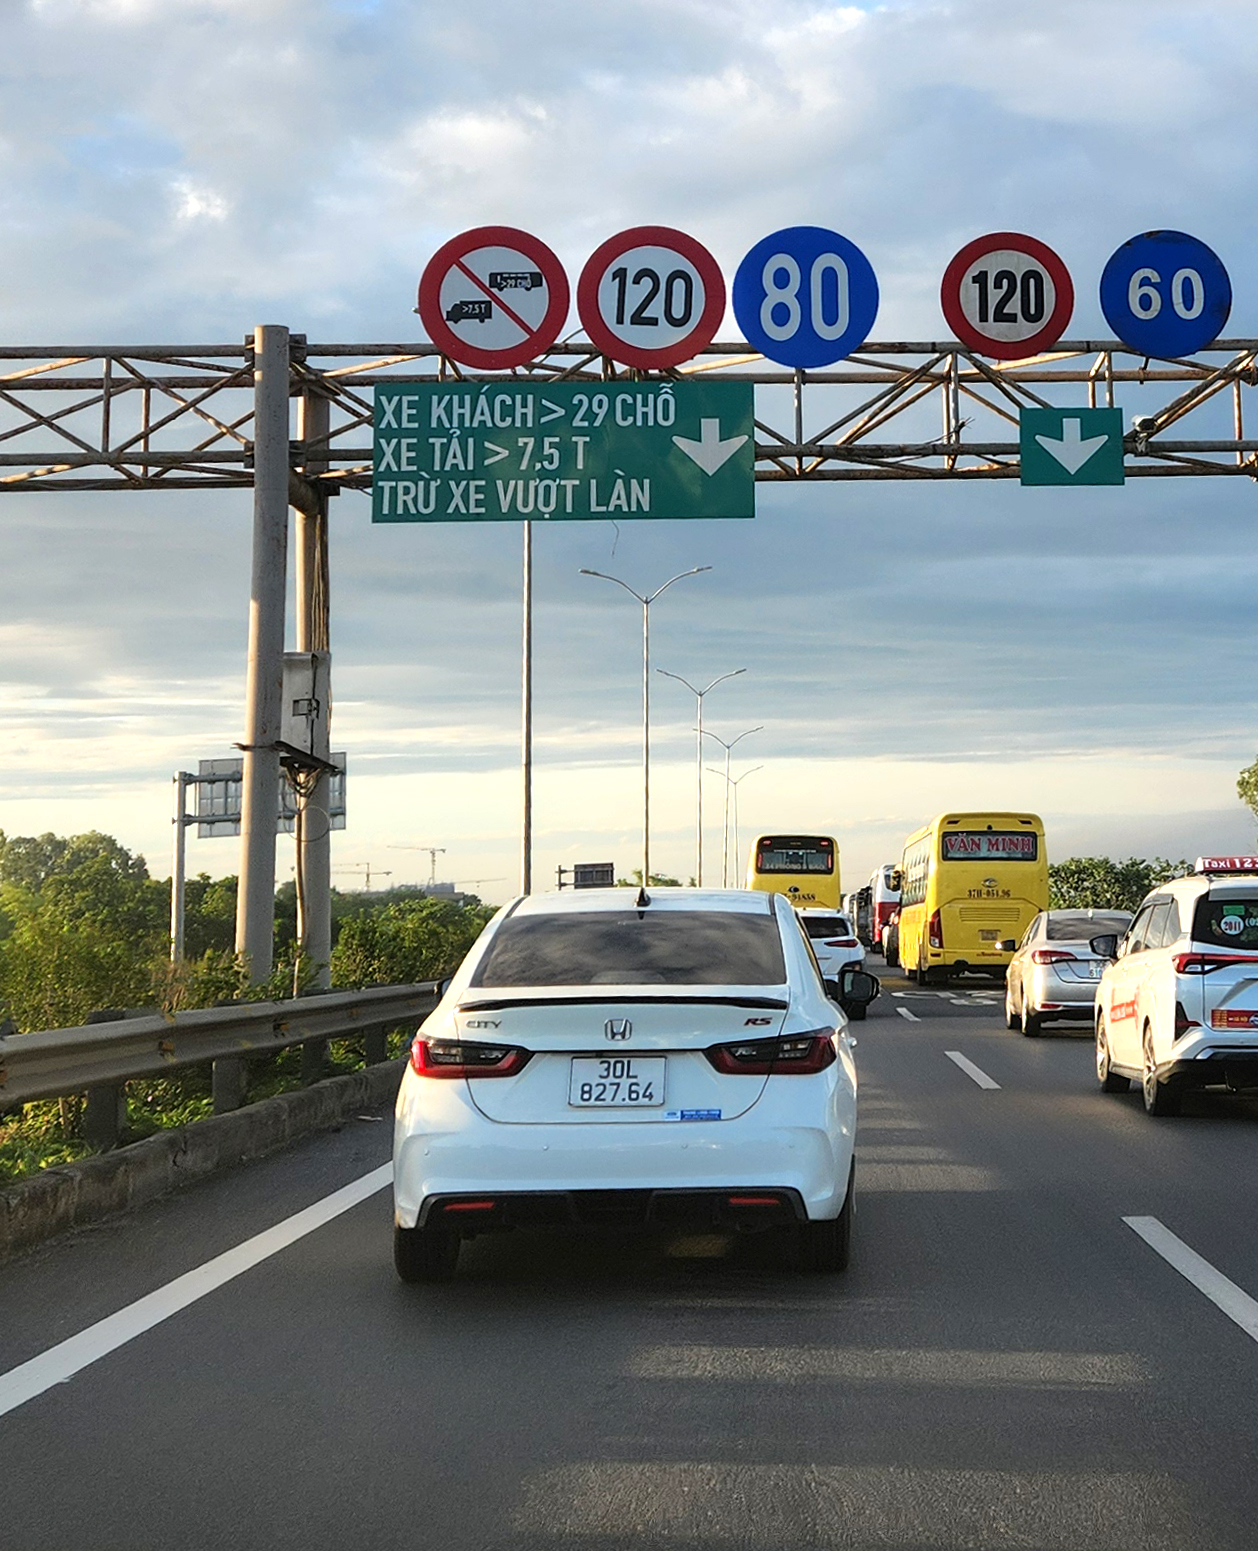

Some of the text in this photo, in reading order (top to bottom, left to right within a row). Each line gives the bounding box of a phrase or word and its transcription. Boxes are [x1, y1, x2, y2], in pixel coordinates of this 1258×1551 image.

[611, 267, 694, 328] 120
[760, 252, 850, 341] 80
[971, 269, 1045, 324] 120
[1128, 268, 1205, 320] 60
[379, 394, 420, 430] XE
[430, 383, 534, 429] KHÁCH
[571, 393, 608, 428] 29
[615, 382, 676, 428] CHỖ
[378, 437, 418, 472] XE
[429, 429, 475, 471] TẢI
[517, 436, 560, 471] 7,5
[571, 436, 590, 469] T
[378, 469, 650, 518] TRỪ XE VƯỢT LÀN
[987, 836, 1033, 852] MINH
[1204, 858, 1230, 868] Taxi
[466, 1020, 502, 1029] CITY
[743, 1017, 773, 1026] RS
[598, 1060, 638, 1079] 30L
[580, 1082, 654, 1102] 827.64
